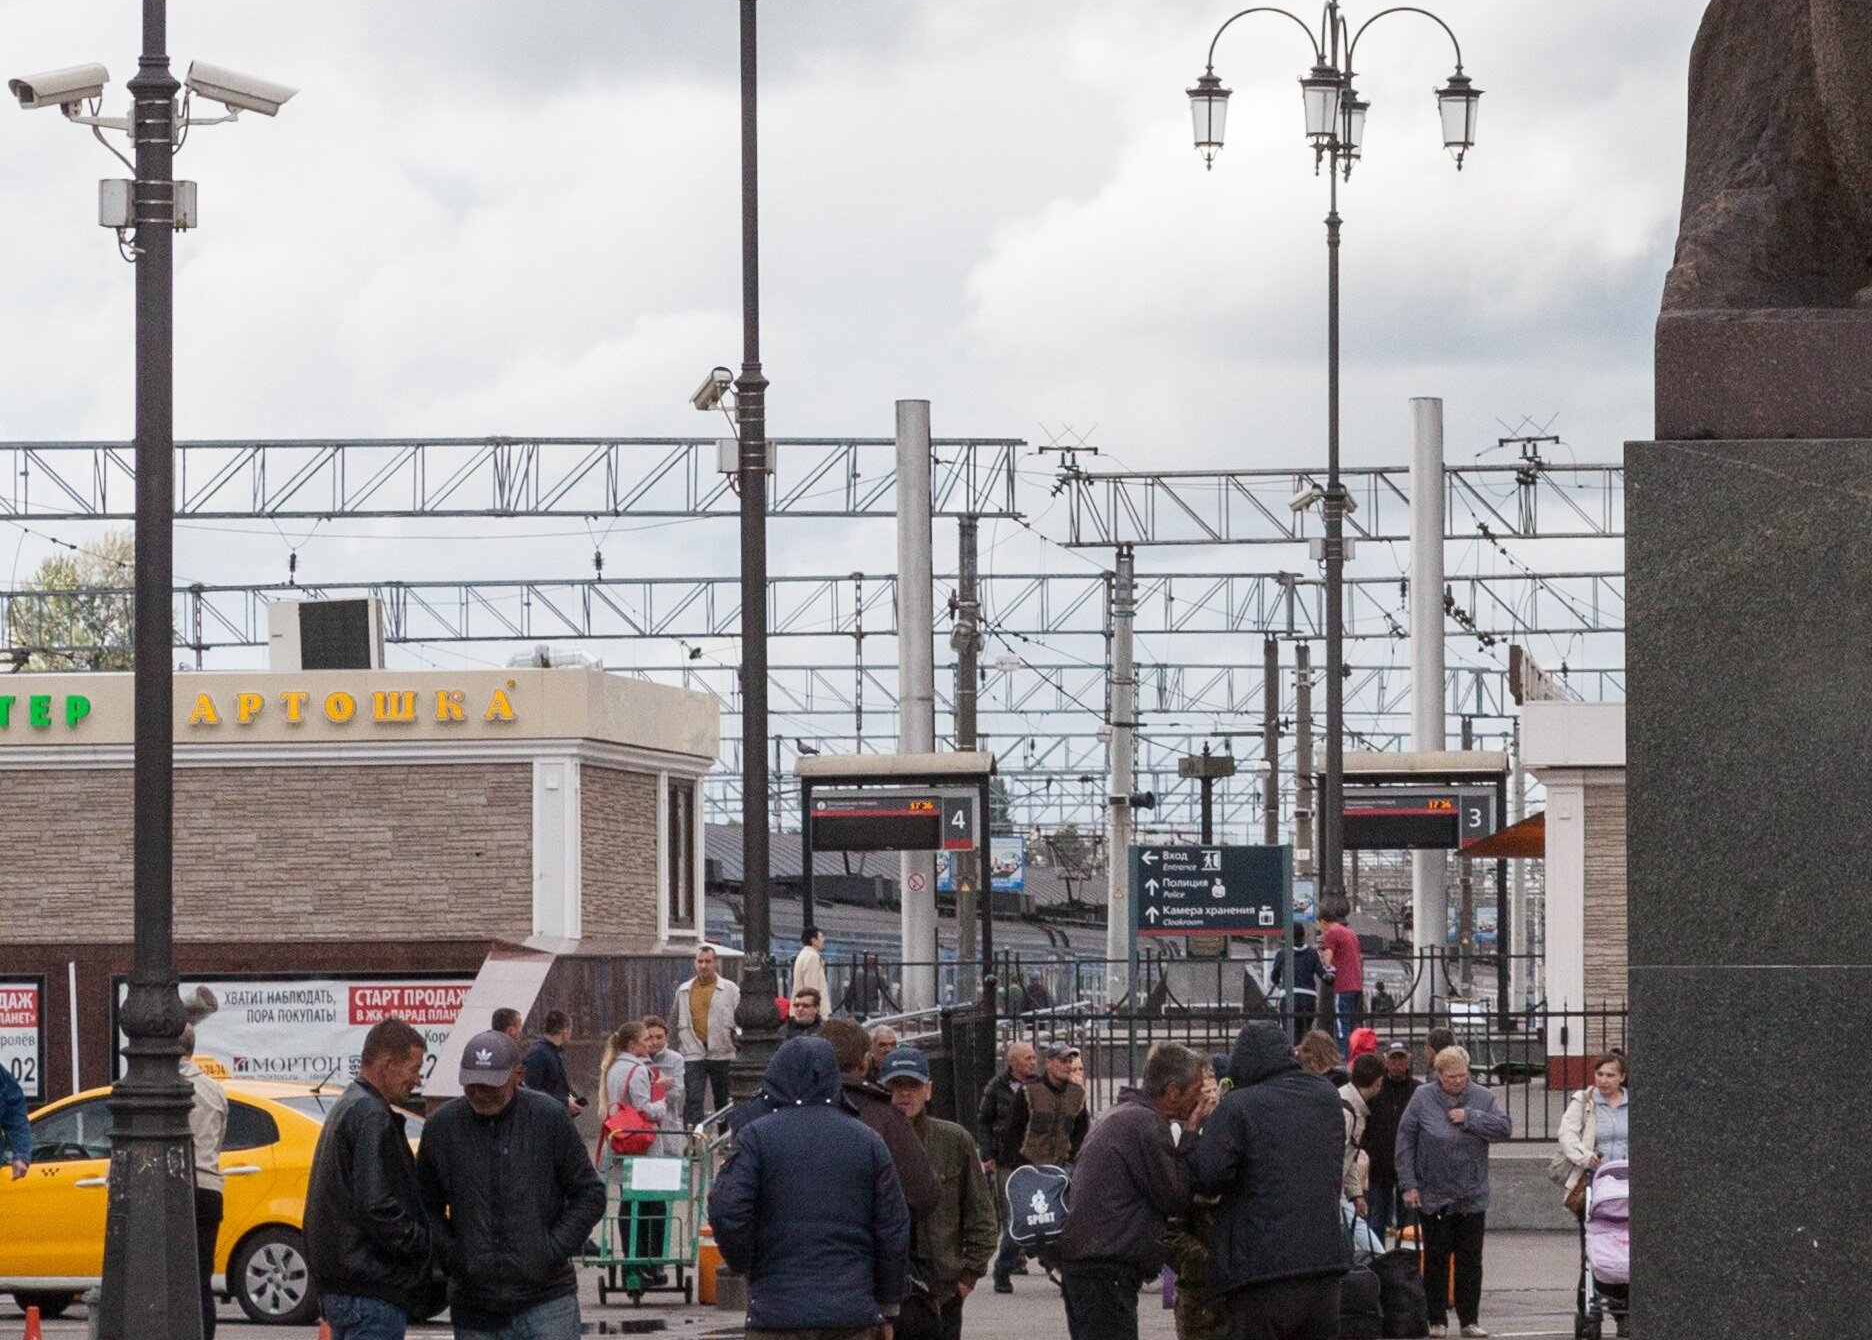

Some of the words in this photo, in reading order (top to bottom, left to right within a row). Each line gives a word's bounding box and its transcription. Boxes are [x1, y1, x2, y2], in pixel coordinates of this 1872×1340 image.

[951, 809, 966, 829] 4
[1469, 808, 1482, 828] 3
[1162, 851, 1188, 862] Вход
[1162, 863, 1198, 871] Entrance
[1162, 878, 1209, 888] Полиция
[1162, 890, 1186, 898] Police
[1162, 906, 1203, 916] Камера
[1205, 907, 1256, 917] хранения
[1162, 918, 1204, 926] Cloakroom
[224, 990, 264, 1006] ХВАТИТ
[267, 989, 337, 1006] НАБЛЮДАТЬ,
[355, 989, 400, 1006] СТАРТ
[246, 1009, 275, 1023] ПОРА
[278, 1008, 337, 1023] ПОКУПАТЬ!
[356, 1009, 364, 1021] В
[366, 1009, 383, 1021] ЖК
[1027, 1211, 1055, 1226] SPORT
